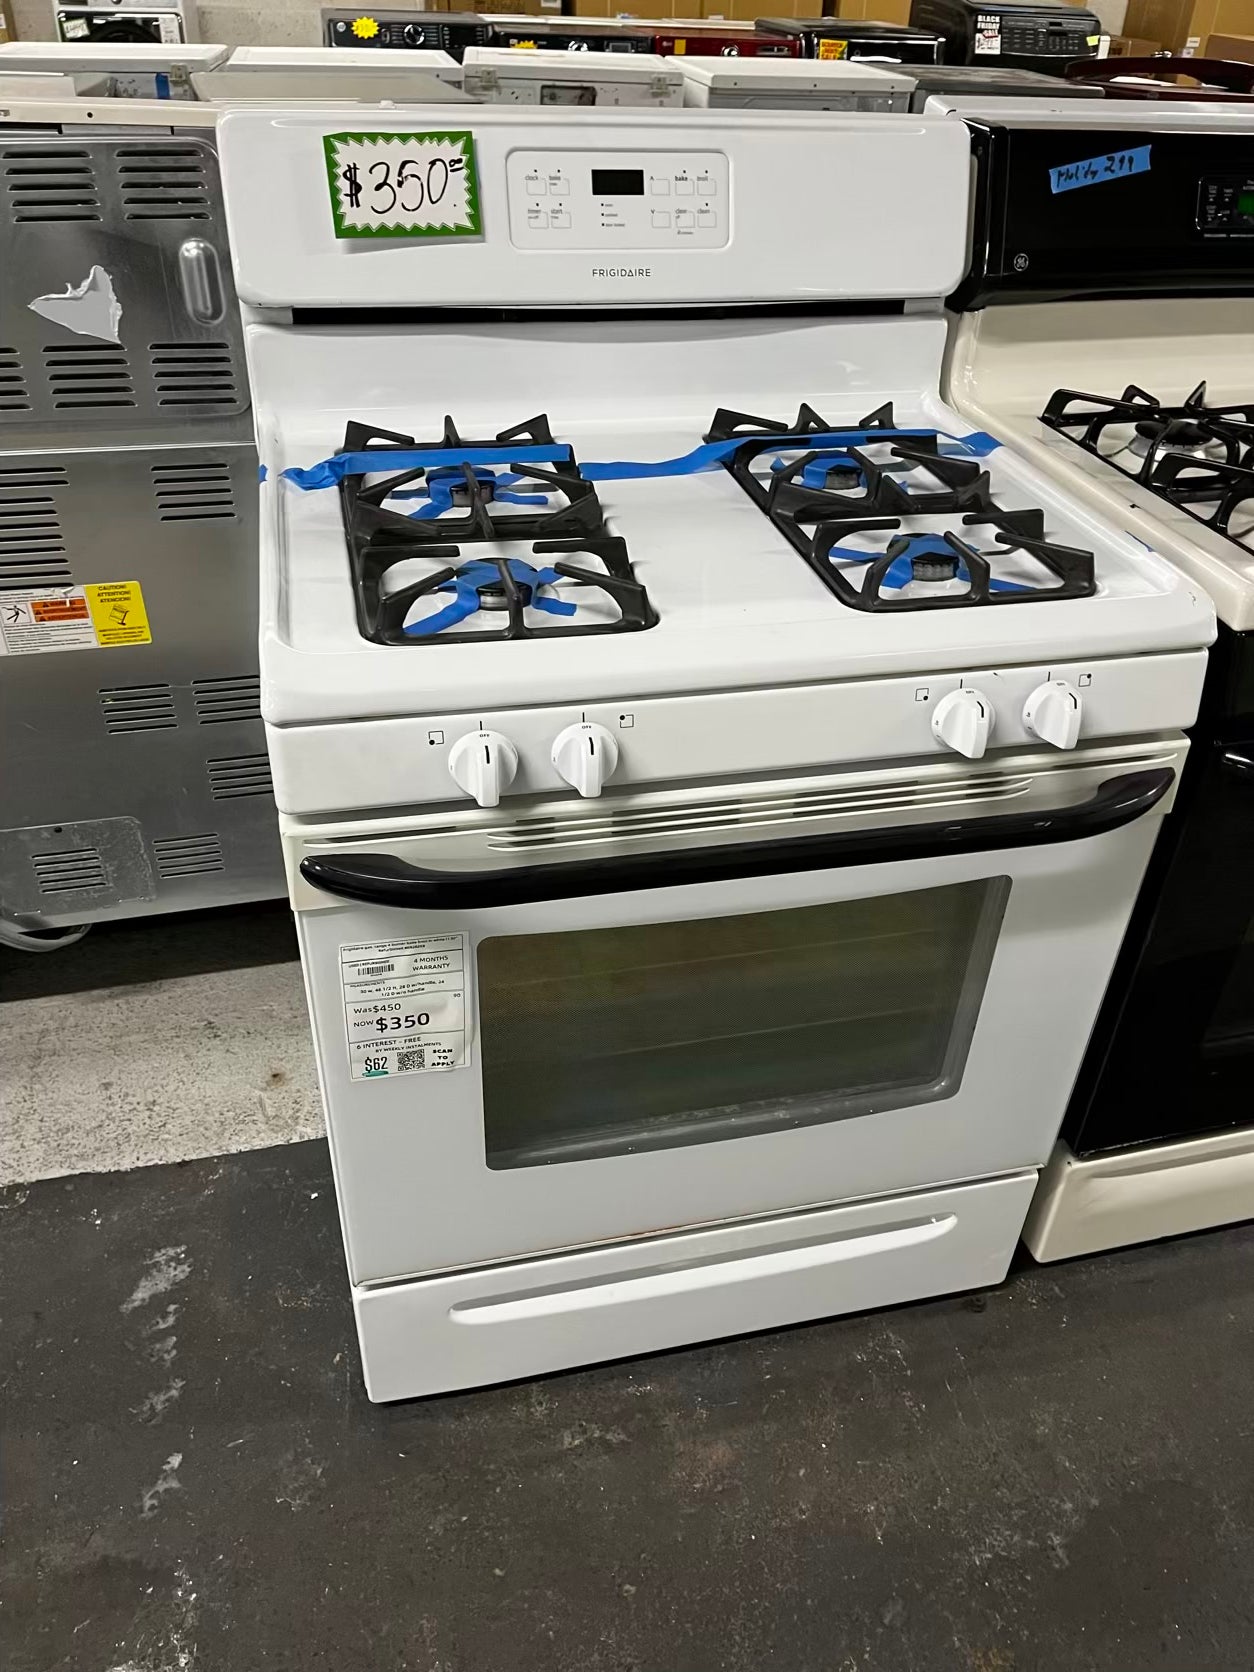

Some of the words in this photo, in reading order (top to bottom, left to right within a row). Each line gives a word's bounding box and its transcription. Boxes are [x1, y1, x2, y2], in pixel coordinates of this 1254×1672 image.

[977, 15, 1000, 23] BLACK
[1104, 155, 1134, 173] 299
[592, 268, 652, 277] FRIGIDAIRE
[419, 955, 449, 963] MONTHS
[412, 963, 451, 972] WARRANTY
[353, 1019, 374, 1028] NOW
[375, 1012, 430, 1033] $350
[362, 1039, 397, 1049] INTEREST
[403, 1036, 421, 1044] FREE
[405, 1042, 442, 1050] INSTALMENTS
[364, 1056, 389, 1073] $62
